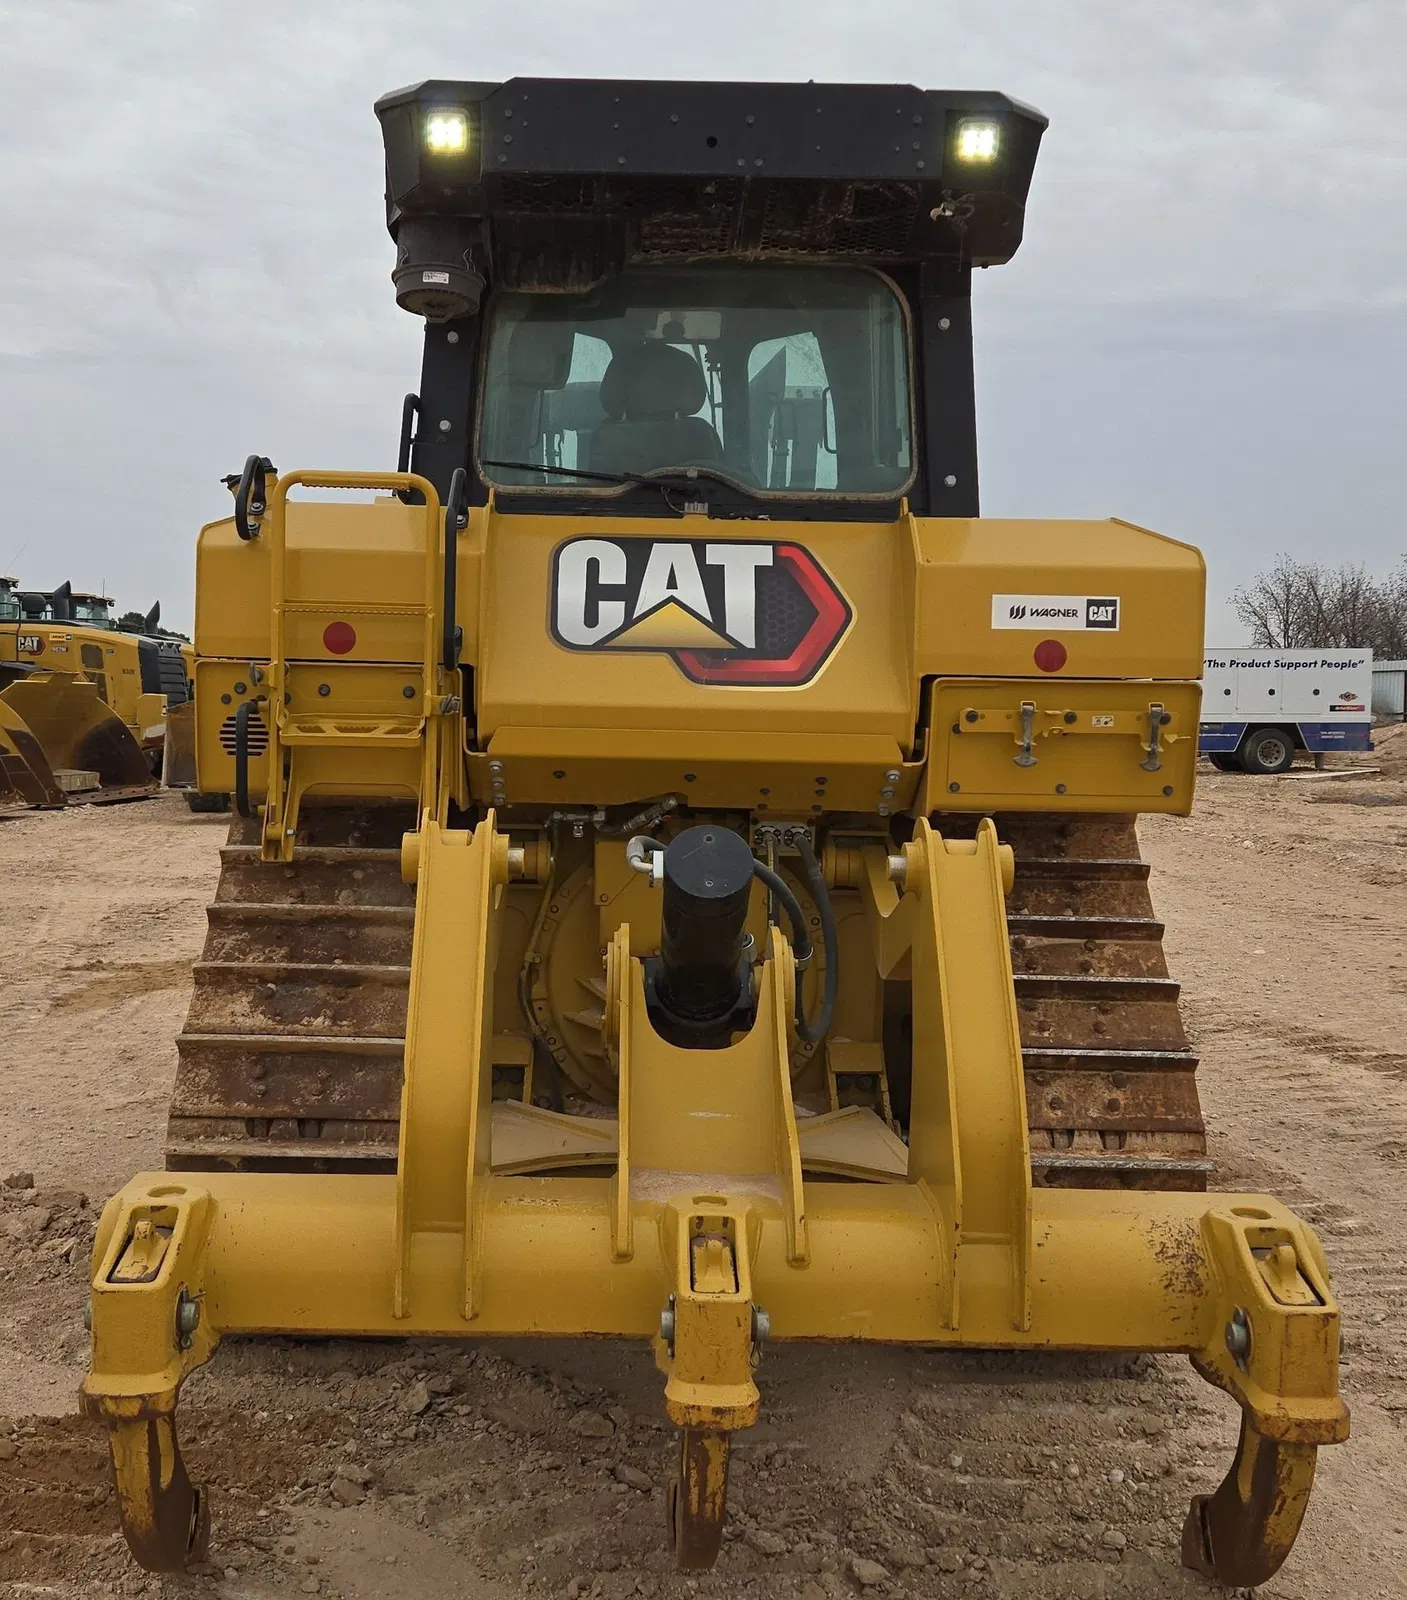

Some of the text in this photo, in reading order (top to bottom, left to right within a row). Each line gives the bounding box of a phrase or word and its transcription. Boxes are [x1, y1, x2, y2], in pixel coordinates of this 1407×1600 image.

[557, 539, 773, 649] CAT
[1030, 605, 1117, 621] WAGNER CAT
[17, 636, 39, 652] CAT
[1229, 659, 1271, 668] Product
[1273, 659, 1318, 671] Support
